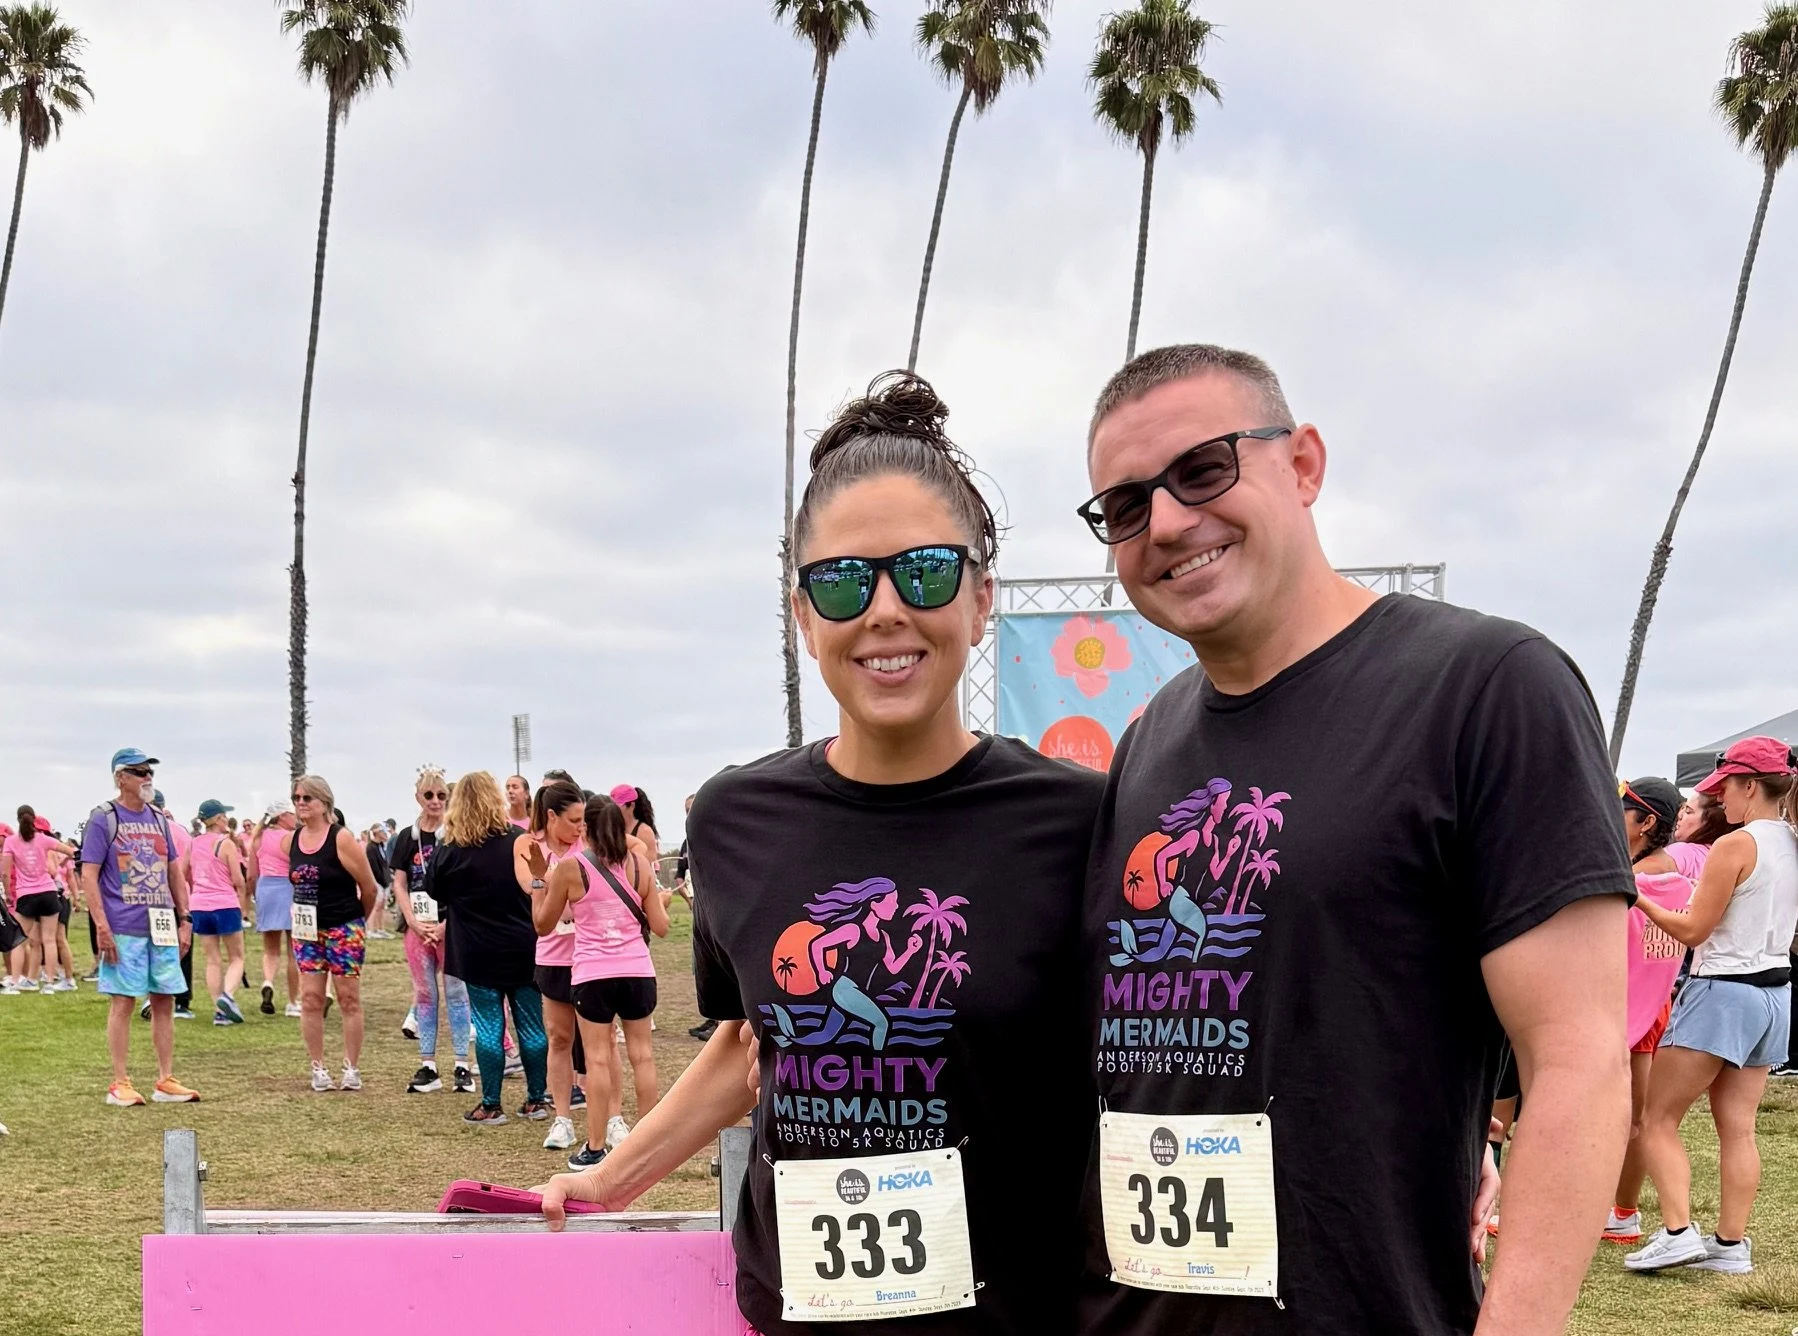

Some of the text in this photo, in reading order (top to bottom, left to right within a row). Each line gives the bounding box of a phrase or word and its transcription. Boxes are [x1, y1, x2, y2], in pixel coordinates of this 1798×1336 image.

[155, 918, 171, 931] 656
[1103, 969, 1253, 1011] MIGHTY
[1099, 1017, 1250, 1050] MERMAIDS
[1096, 1051, 1245, 1066] ANDERSON AQUATICS
[1097, 1062, 1134, 1073] POOL
[1156, 1062, 1172, 1074] 5K
[1183, 1063, 1243, 1077] SQUAD
[775, 1051, 948, 1093] MIGHTY
[773, 1092, 948, 1126] MERMAIDS
[776, 1122, 945, 1141] ANDERSON AQUATICS
[821, 1137, 840, 1148] TO
[852, 1137, 873, 1148] 5K
[885, 1138, 943, 1150] SQUAD
[1185, 1136, 1242, 1155] HOKA
[877, 1170, 933, 1192] HOKA
[1128, 1173, 1234, 1248] 334
[811, 1209, 927, 1280] 333
[1187, 1262, 1215, 1274] Travis
[807, 1293, 837, 1308] Let's
[840, 1299, 854, 1311] go
[875, 1289, 917, 1301] Breanna
